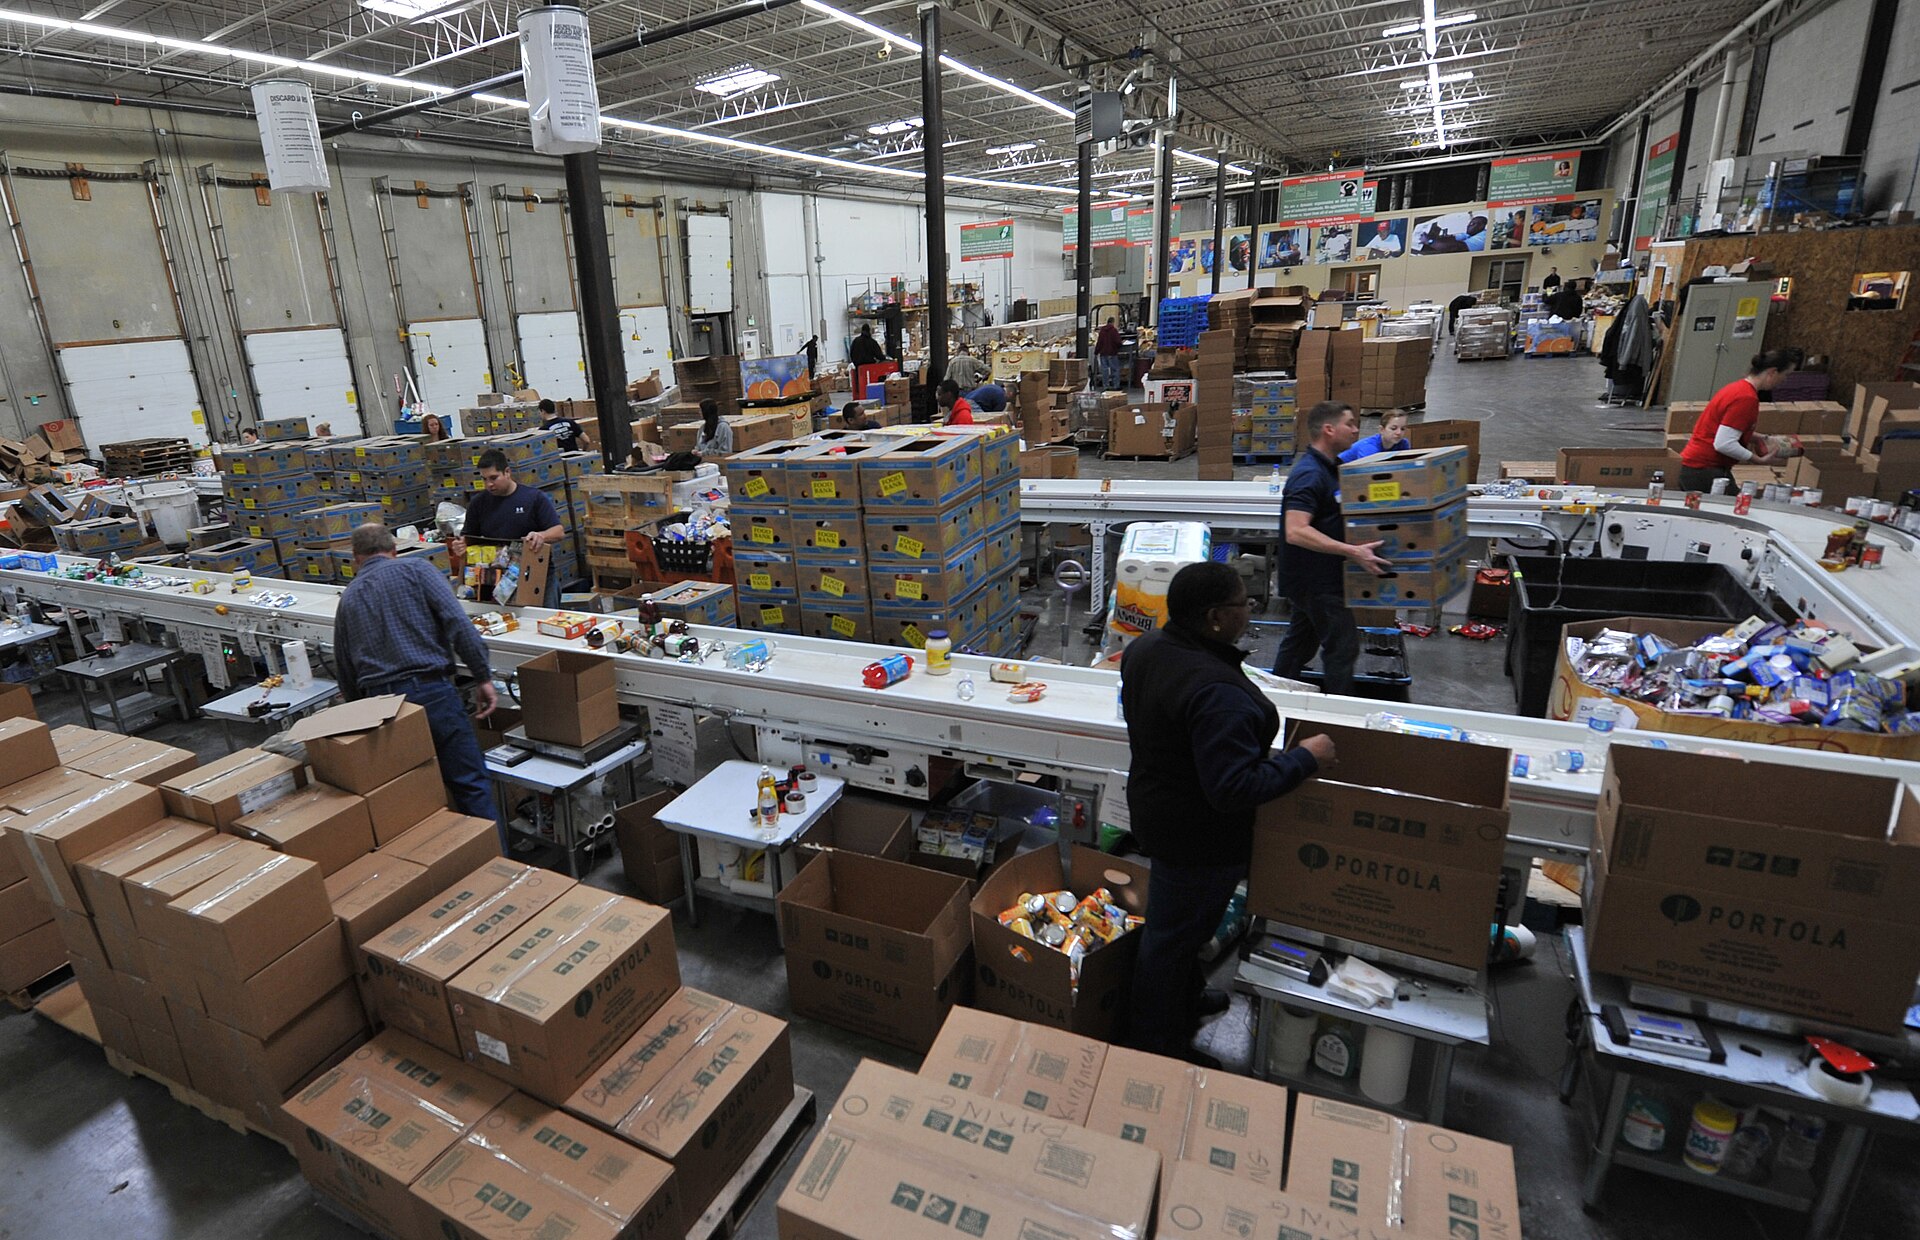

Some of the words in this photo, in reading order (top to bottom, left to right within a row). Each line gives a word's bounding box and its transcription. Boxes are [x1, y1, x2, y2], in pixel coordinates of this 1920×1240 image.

[285, 309, 292, 319] 5
[112, 319, 120, 329] 6
[882, 474, 902, 485] FOOD
[884, 481, 904, 490] BANK
[753, 527, 772, 535] FOOD
[754, 532, 773, 540] BANK
[817, 531, 837, 539] FOOD
[817, 536, 837, 544] BANK
[900, 537, 921, 548] FOOD
[898, 542, 919, 553] BANK
[822, 582, 841, 593] BANK
[823, 577, 843, 588] FOOD
[1336, 854, 1442, 893] PORTOLA
[1708, 906, 1848, 950] PORTOLA
[596, 941, 651, 998] PORTOLA
[384, 964, 440, 998] PORTOLA
[835, 968, 903, 1000] PORTOLA
[998, 978, 1066, 1023] PORTOLA
[721, 1061, 772, 1126] PORTOLA
[932, 1094, 1068, 1142] BAKING
